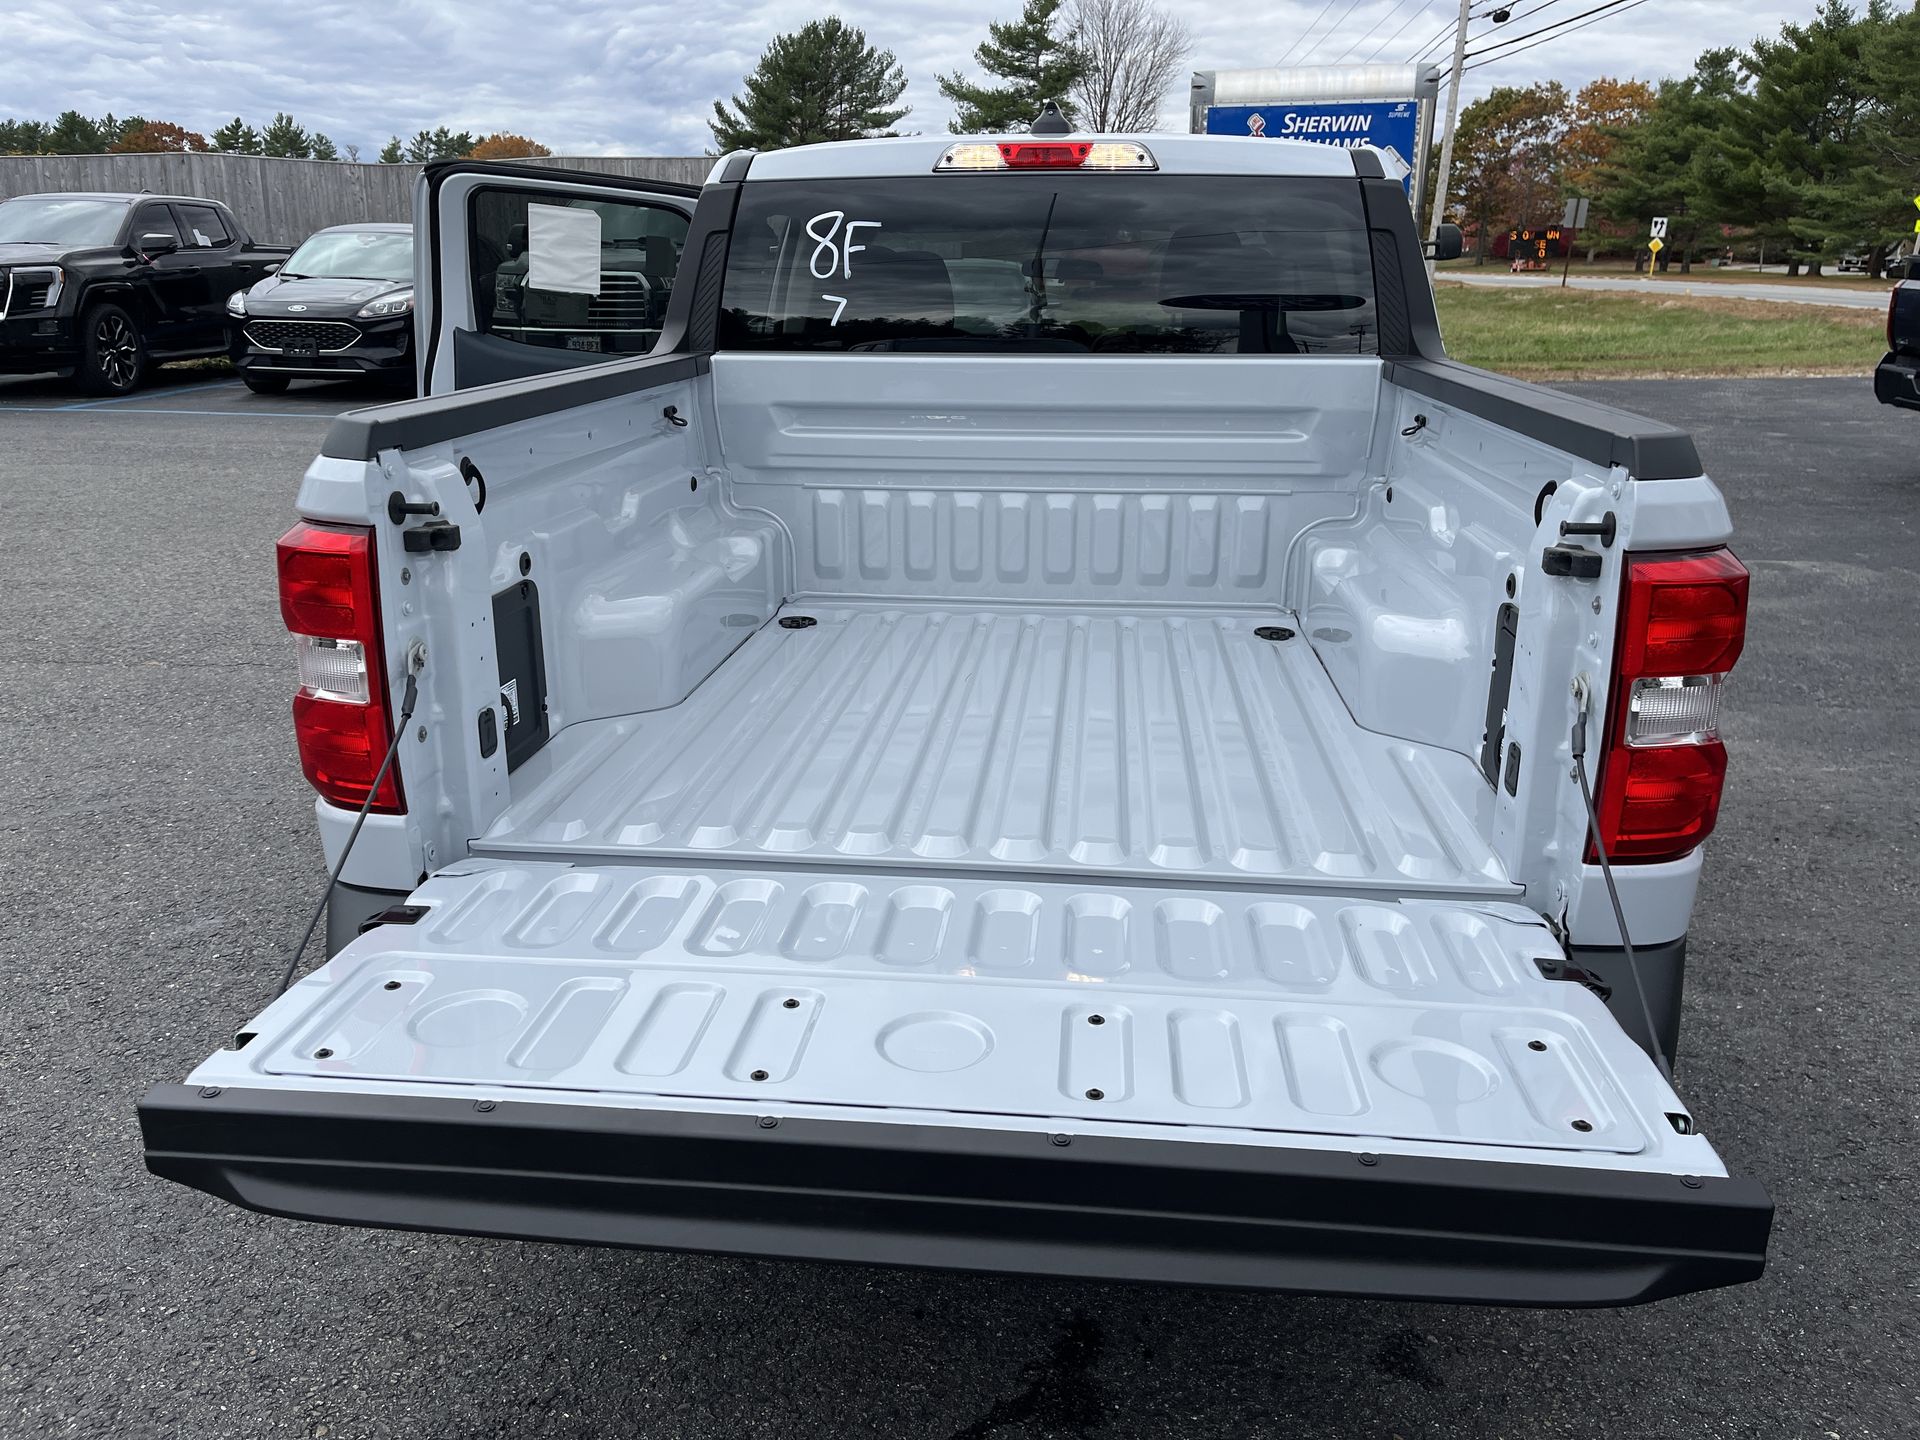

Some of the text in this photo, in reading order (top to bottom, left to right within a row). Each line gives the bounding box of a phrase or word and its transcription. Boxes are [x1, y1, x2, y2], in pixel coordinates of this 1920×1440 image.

[1281, 113, 1372, 134] SHERWIN
[806, 210, 882, 279] 8F
[822, 294, 848, 327] 7
